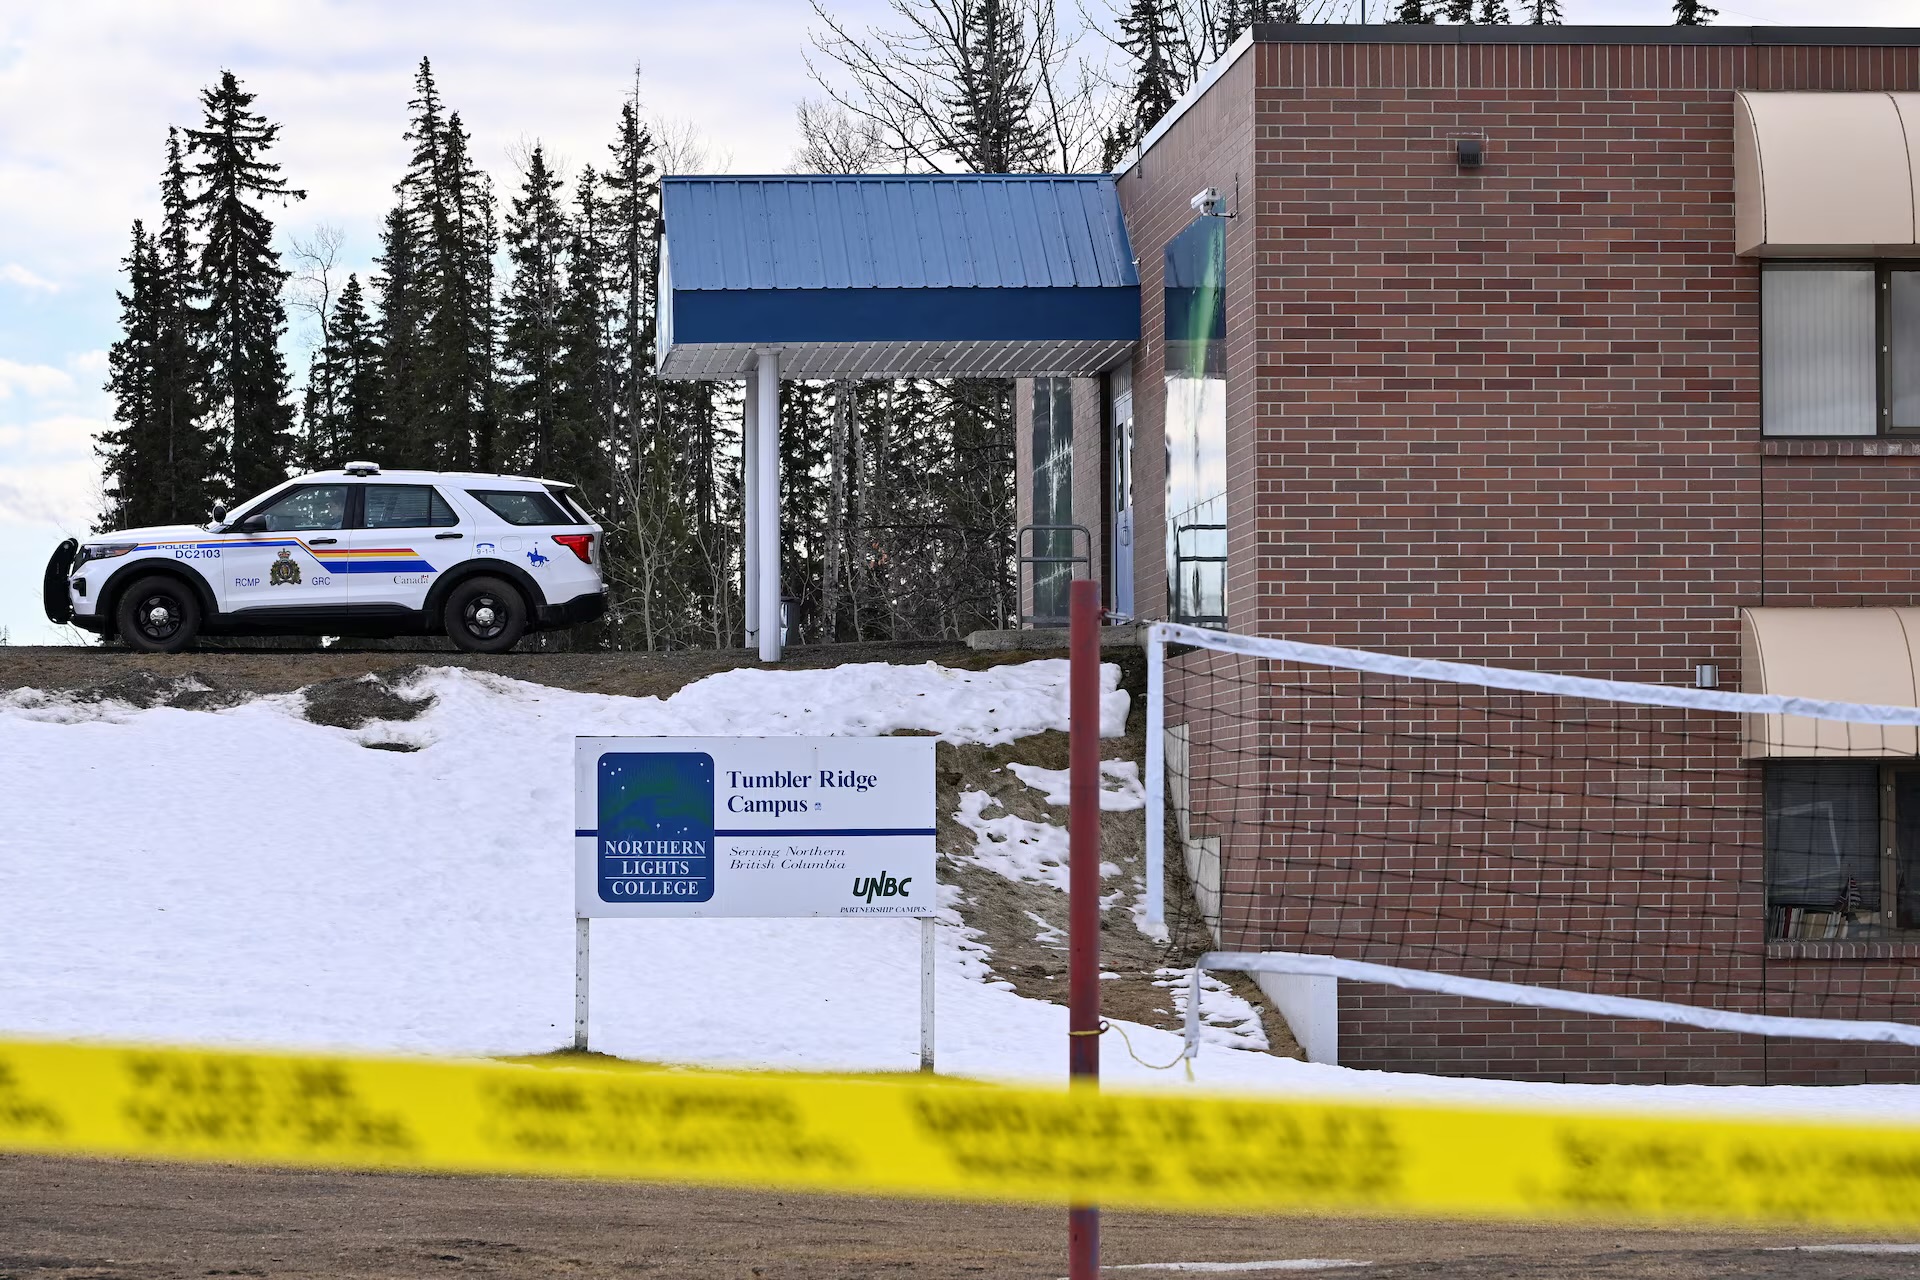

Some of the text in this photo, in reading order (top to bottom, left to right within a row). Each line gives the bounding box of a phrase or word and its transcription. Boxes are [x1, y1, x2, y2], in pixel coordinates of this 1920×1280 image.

[175, 549, 221, 559] DC2103
[235, 577, 331, 587] RCMP GRC
[393, 575, 429, 585] Canada
[726, 770, 878, 793] Tumbler Ridge
[727, 794, 808, 818] Campus
[605, 840, 706, 855] NORTHERN
[729, 845, 846, 859] Serving Northern
[622, 860, 690, 875] LIGHTS
[730, 859, 847, 870] British Columbia
[611, 880, 699, 896] COLLEGE
[852, 870, 912, 904] UNBC
